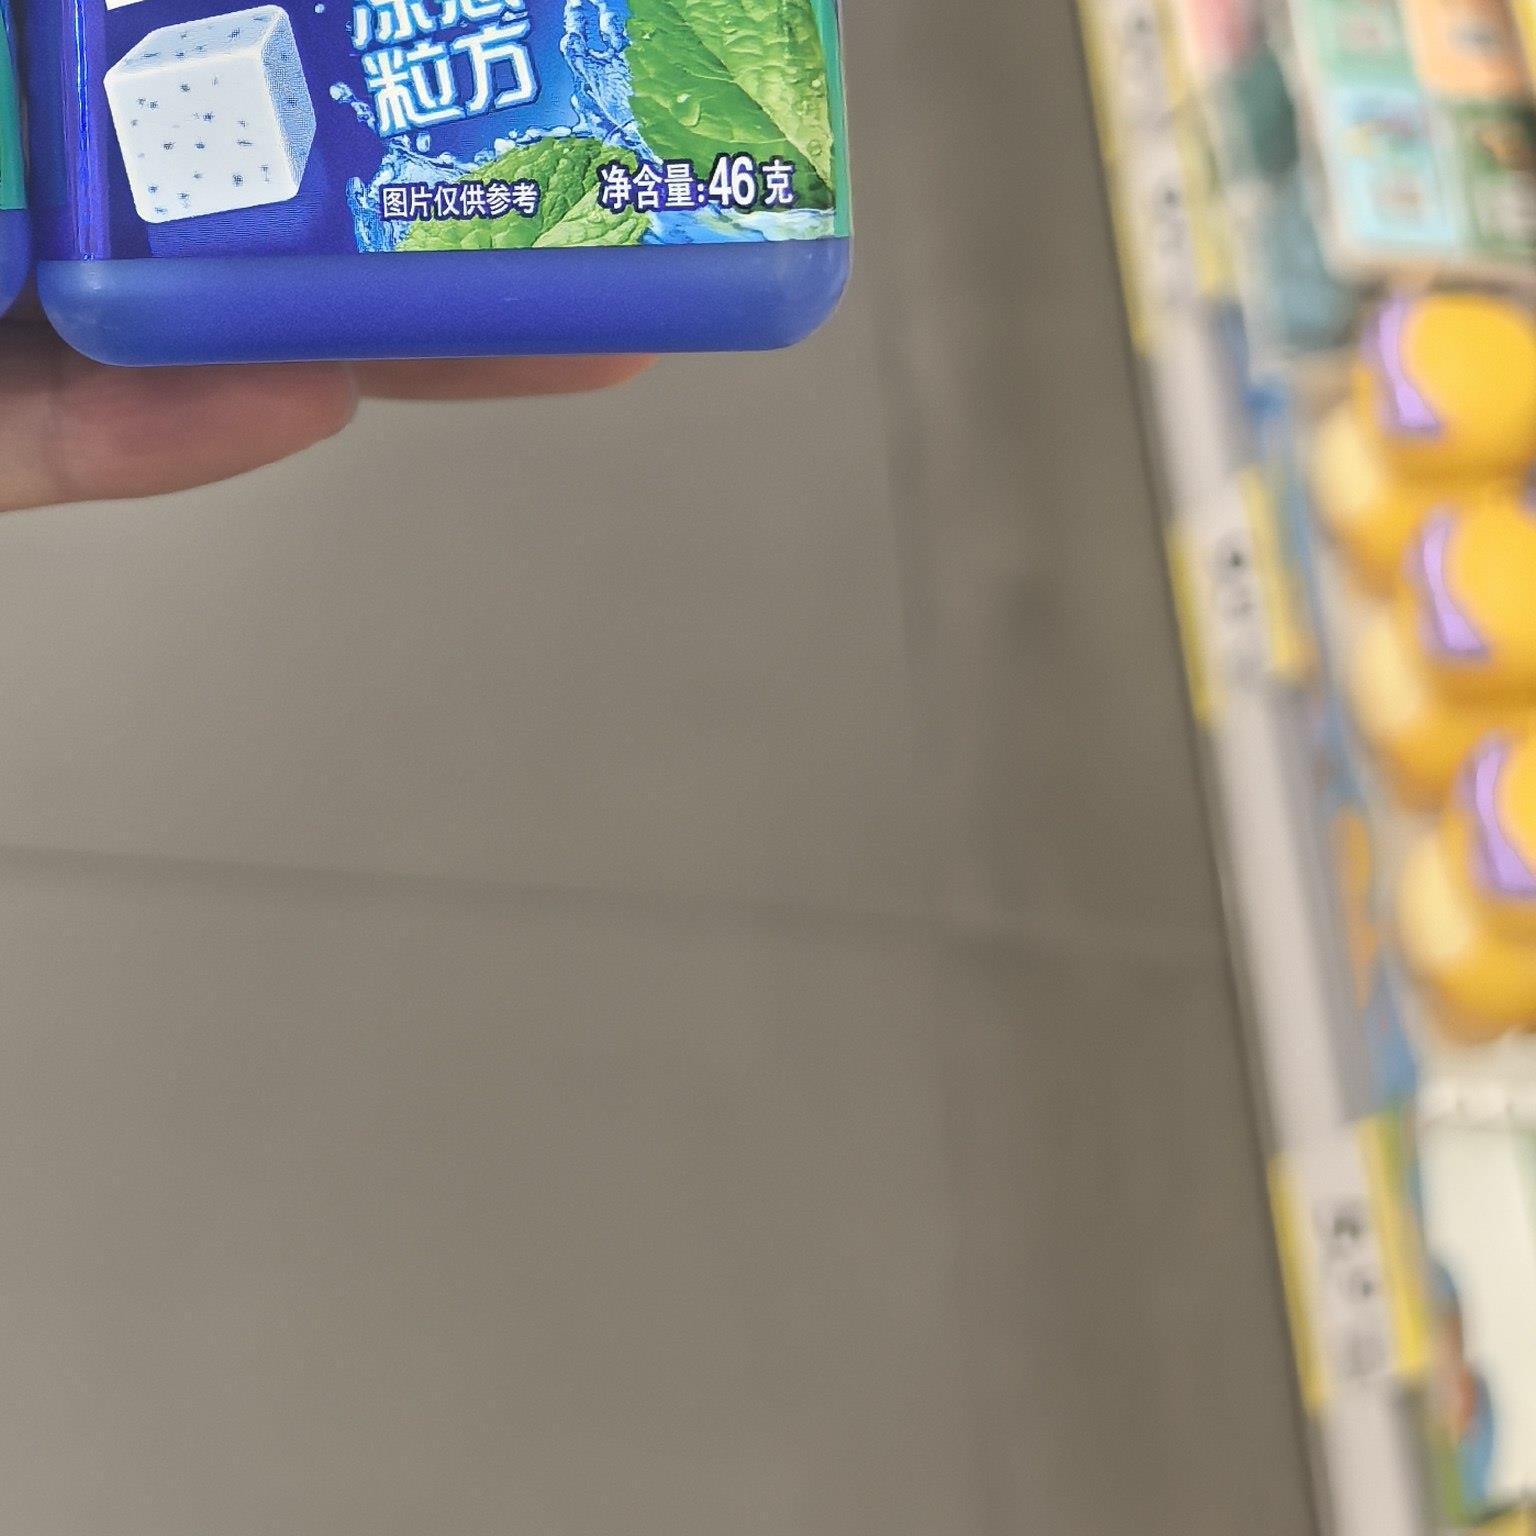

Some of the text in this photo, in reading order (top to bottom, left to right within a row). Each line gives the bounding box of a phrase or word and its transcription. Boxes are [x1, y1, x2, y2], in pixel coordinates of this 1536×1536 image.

[362, 15, 540, 135] 粒方
[382, 181, 538, 217] 图片仅供参考
